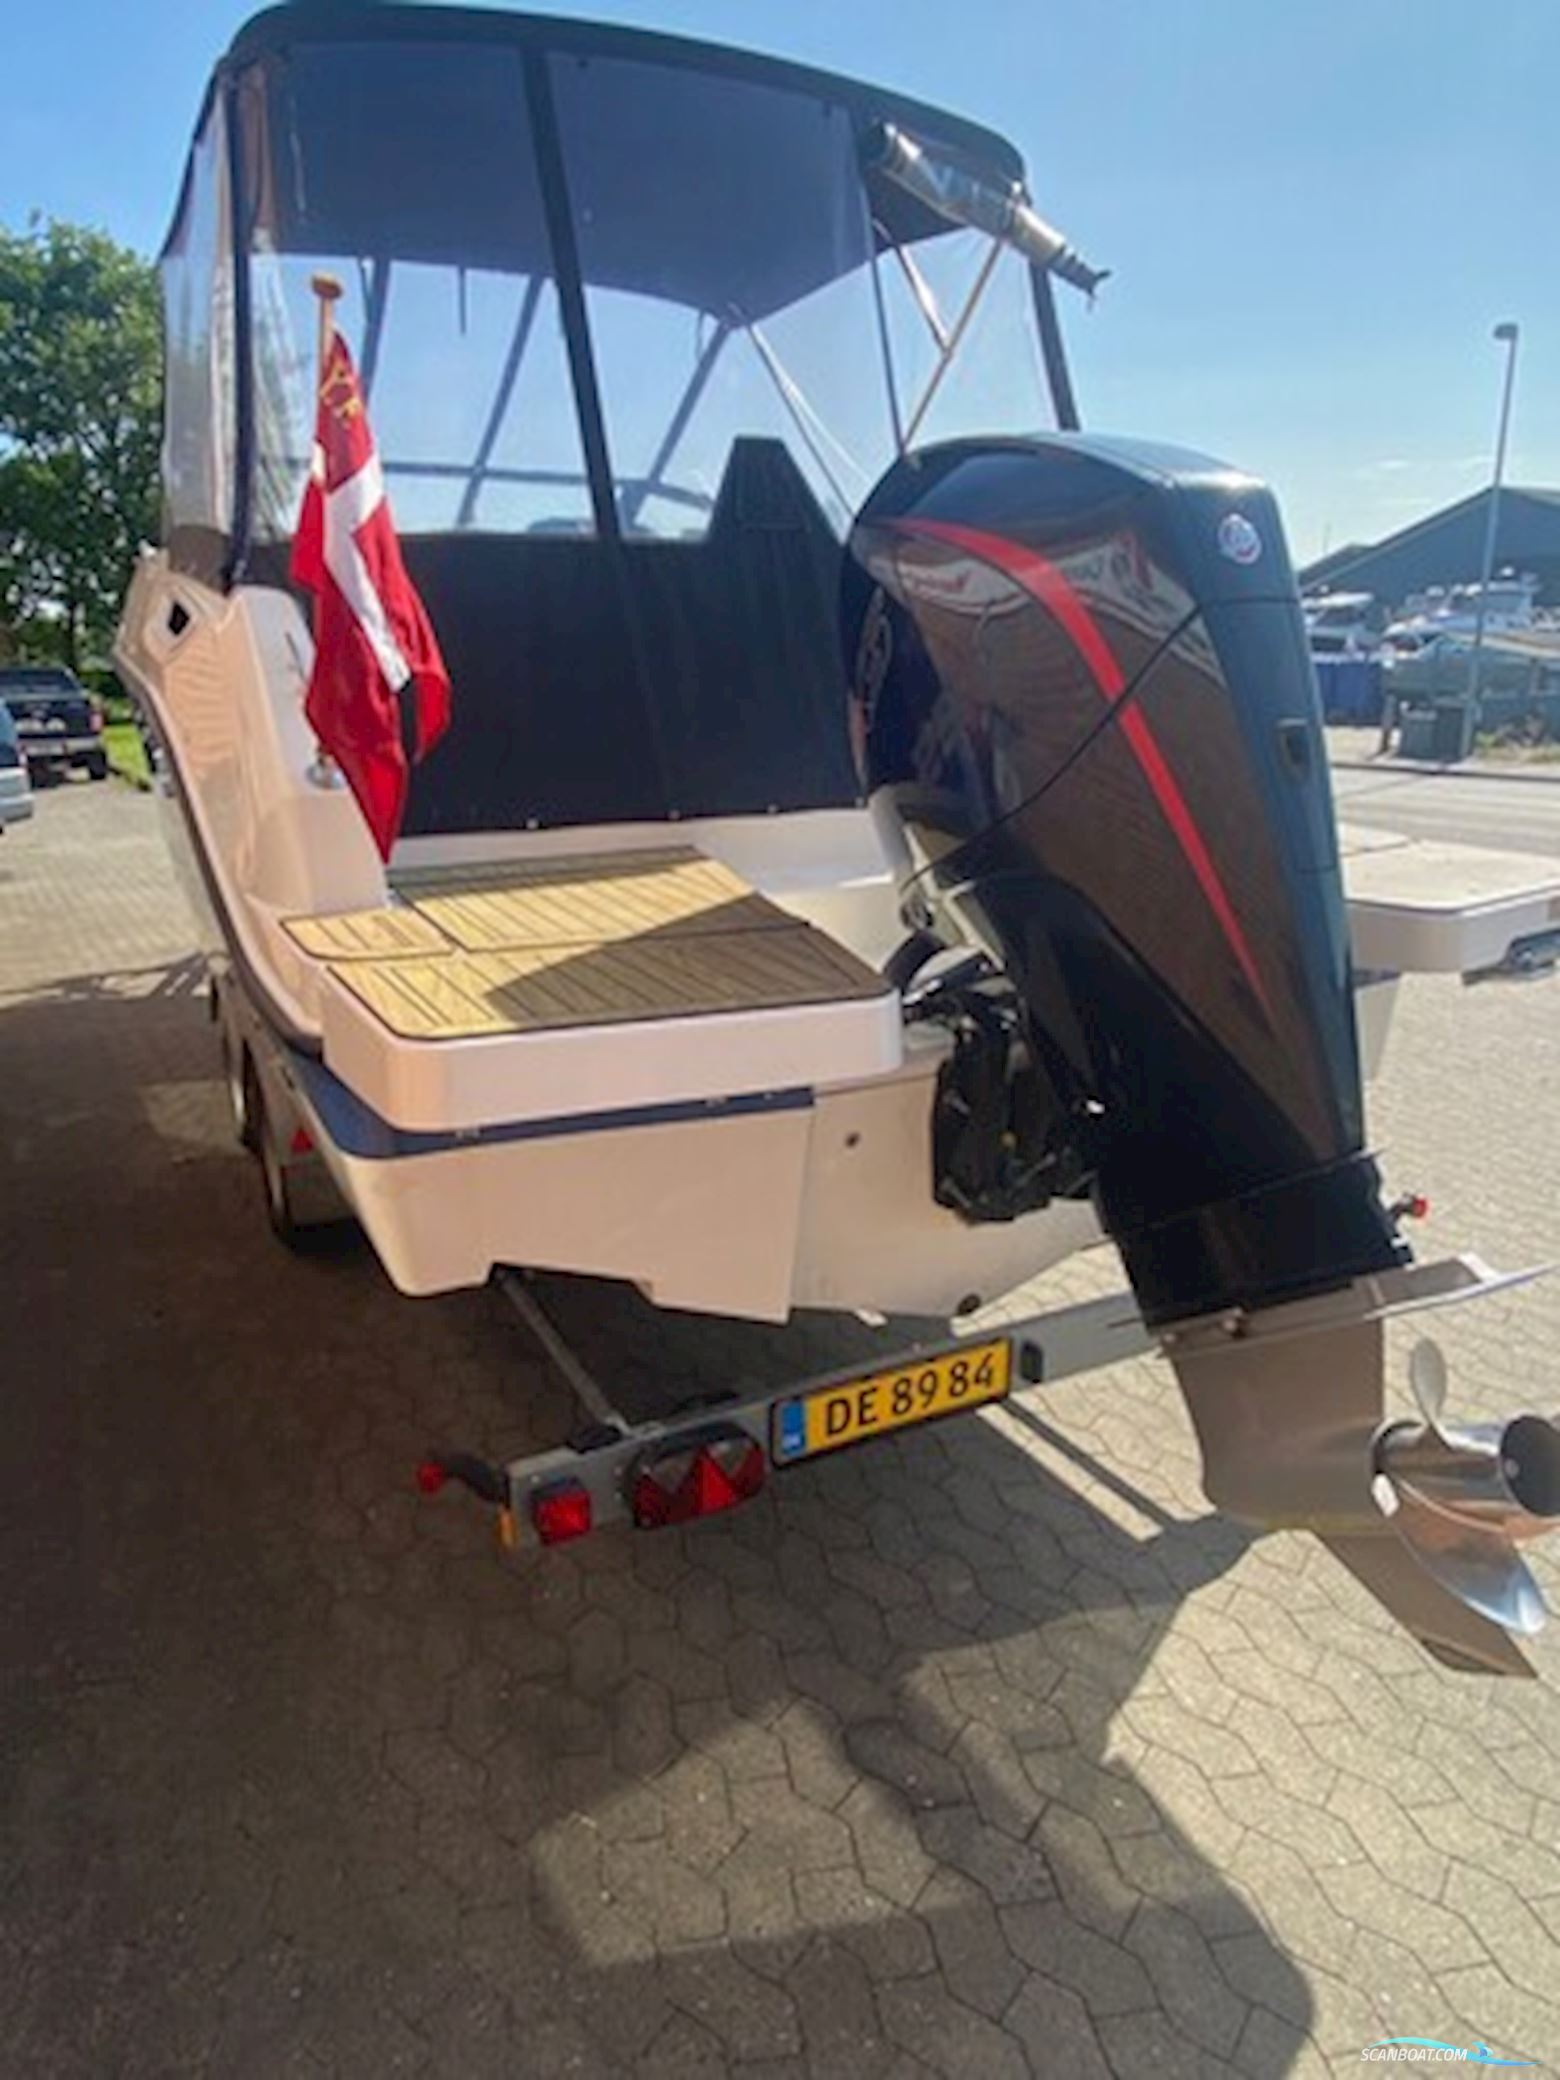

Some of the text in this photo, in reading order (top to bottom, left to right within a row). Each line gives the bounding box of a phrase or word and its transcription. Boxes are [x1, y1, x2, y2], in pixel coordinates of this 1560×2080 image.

[826, 1352, 994, 1437] DE 89 84
